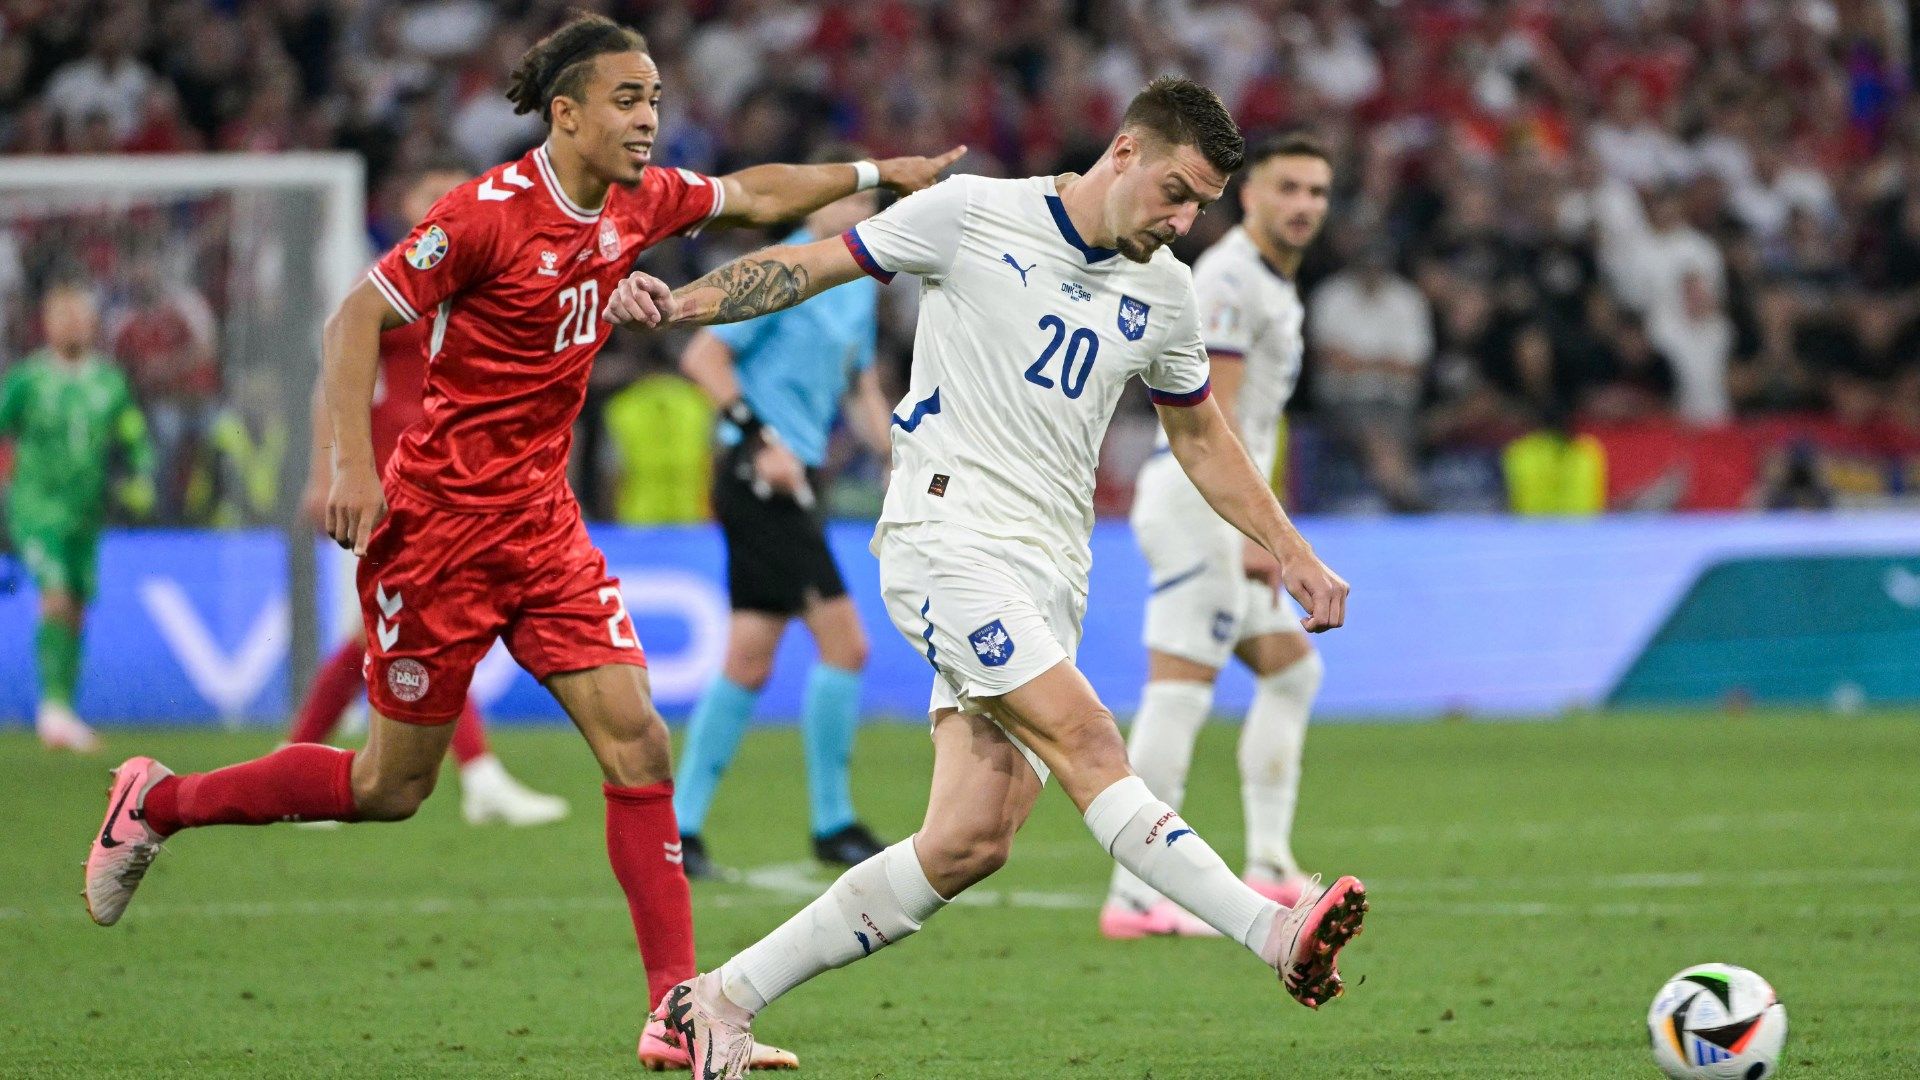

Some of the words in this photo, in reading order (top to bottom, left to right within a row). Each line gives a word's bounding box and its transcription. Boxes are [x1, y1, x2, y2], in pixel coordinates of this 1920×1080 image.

[554, 278, 599, 353] 20
[1024, 314, 1100, 399] 20
[598, 587, 643, 650] 2
